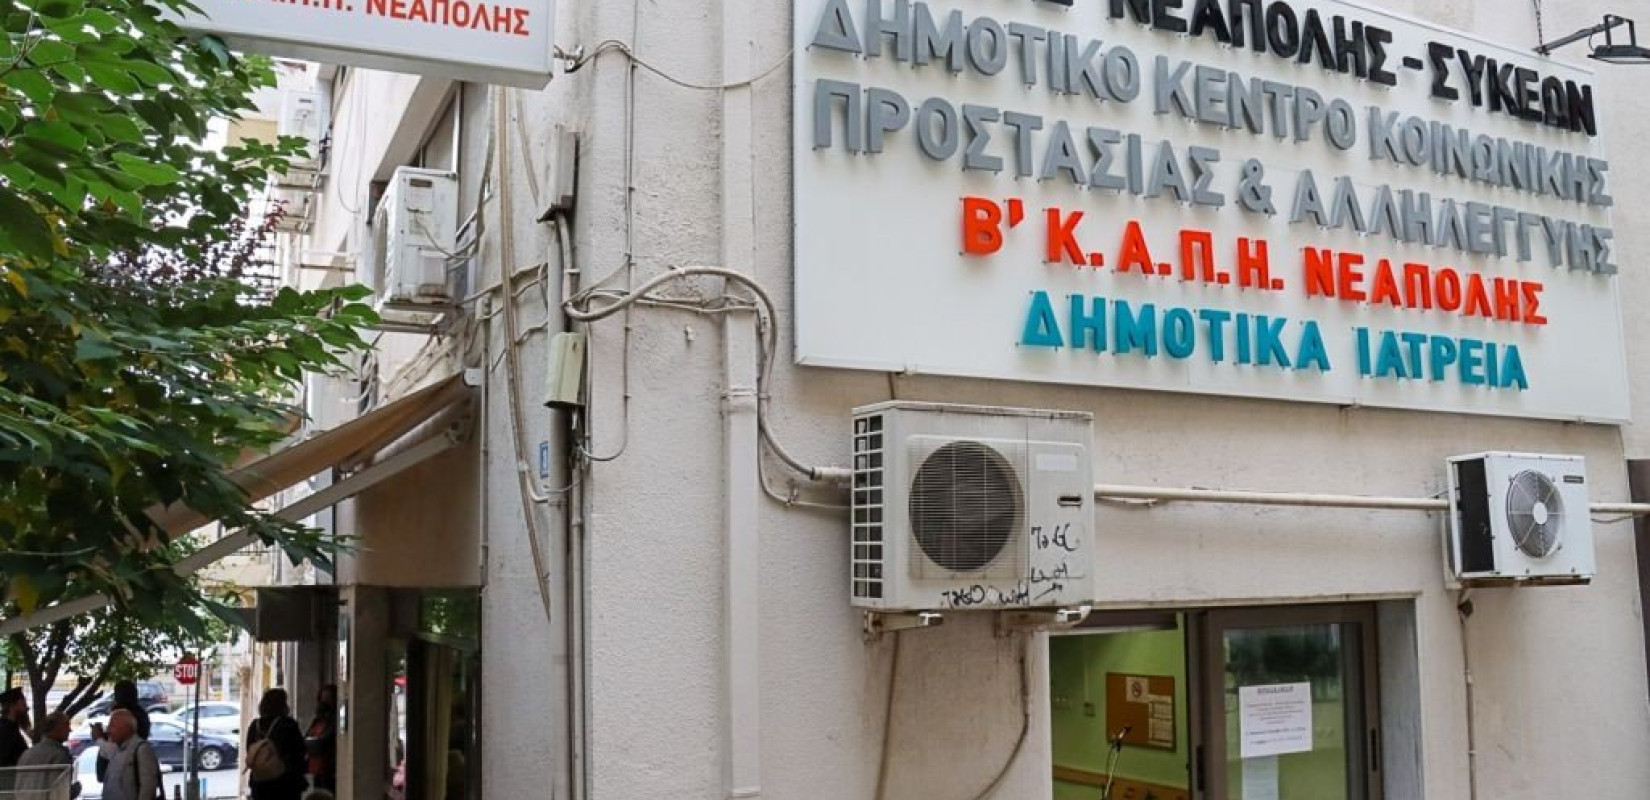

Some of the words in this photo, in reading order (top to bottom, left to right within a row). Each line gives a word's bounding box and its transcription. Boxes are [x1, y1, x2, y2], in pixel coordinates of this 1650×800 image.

[366, 0, 531, 36] ΝΕΑΠΟΛΗΣ
[809, 0, 1141, 103] ΔΗΜΟΤΙΚΟ
[1154, 55, 1356, 151] ΚΕΝΤΡΟ
[1367, 105, 1614, 206] ΚΟΙΝΩΝΙΚΗΣ
[813, 78, 1226, 207] ΠΡΟΣΤΑΣΙΑΣ
[1239, 157, 1277, 215] &
[1289, 168, 1618, 275] ΑΛΛΗΛΕΓΓΥΗΣ
[1304, 246, 1548, 325] ΝΕΑΠΟΛΗΣ
[1020, 289, 1332, 372] ΔΗΜΟΤΙΚΑ
[1355, 326, 1529, 391] ΙΑΤΡΕΙΑ
